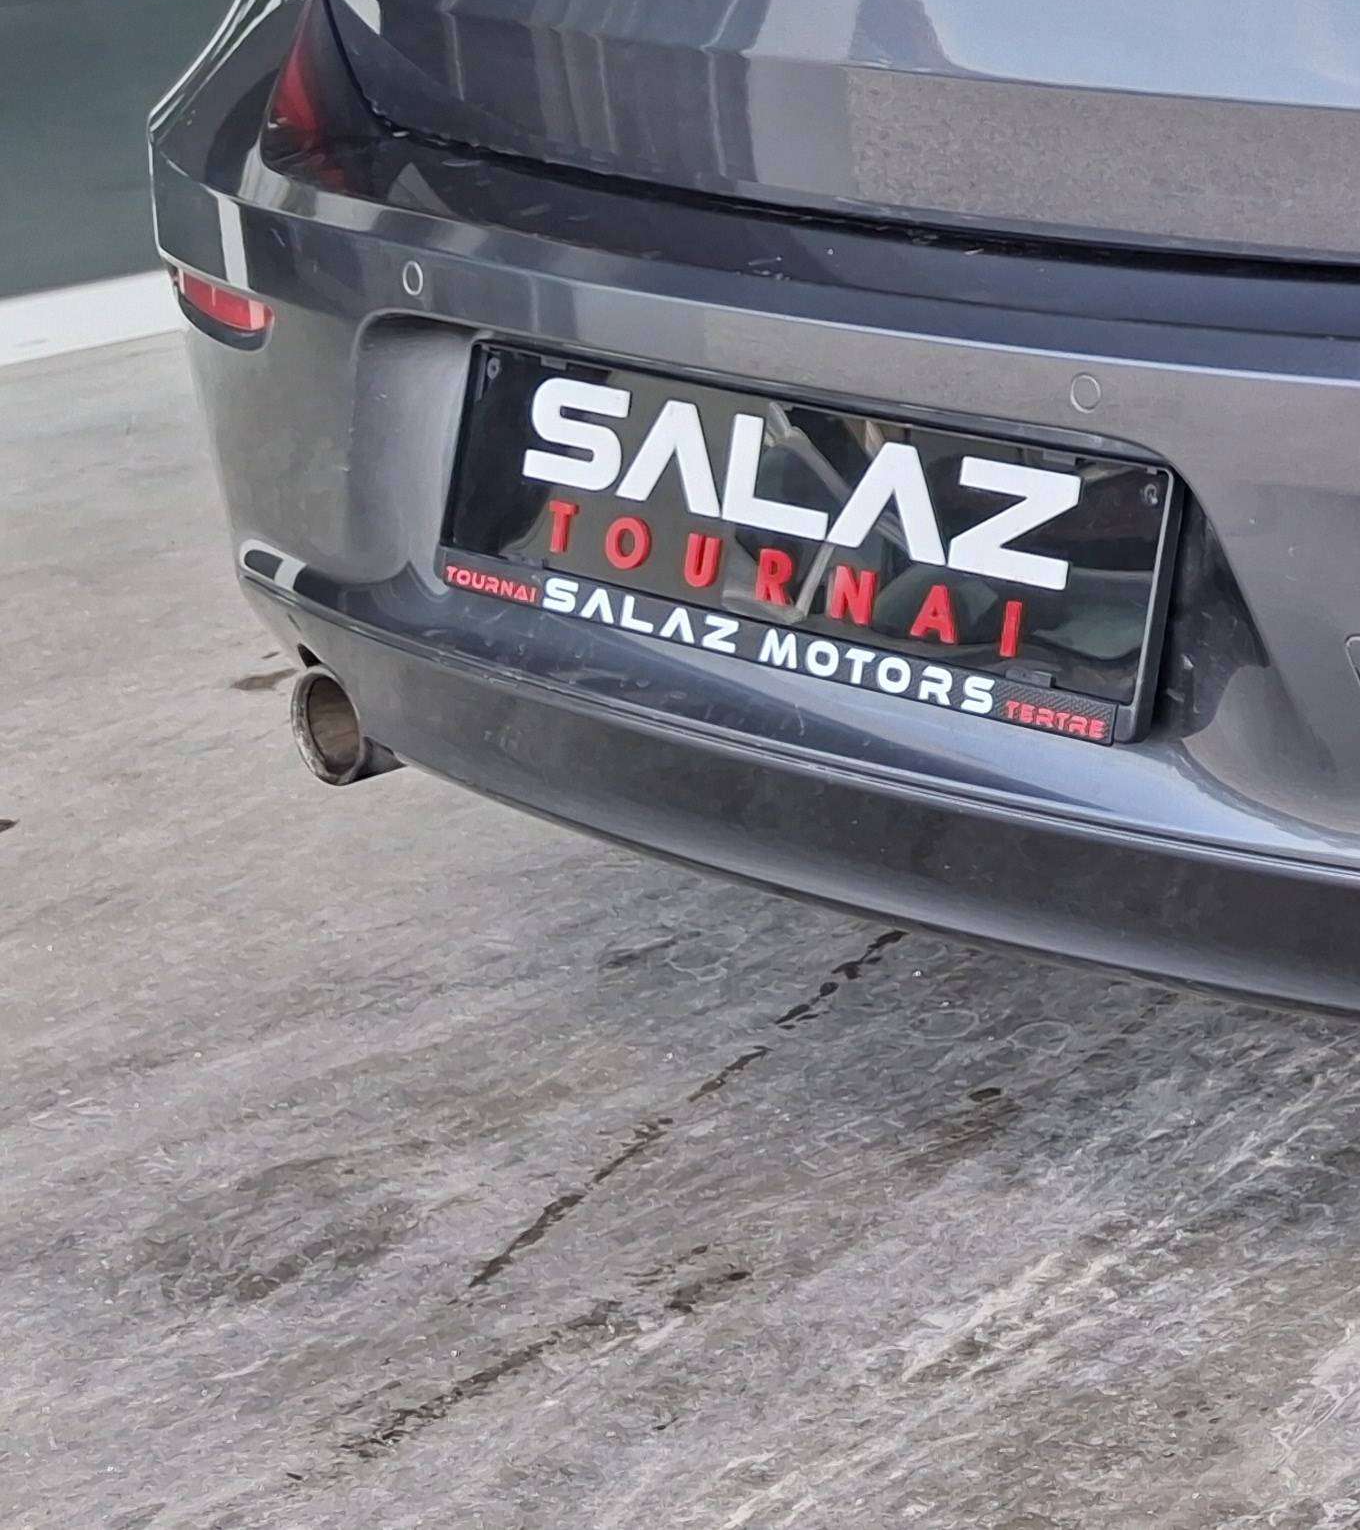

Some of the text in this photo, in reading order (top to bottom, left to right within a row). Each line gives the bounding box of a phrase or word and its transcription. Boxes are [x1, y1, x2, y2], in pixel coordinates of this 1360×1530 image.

[521, 376, 1083, 592] SALAZ
[445, 564, 1108, 741] TOURNAI SALAZ MOTORS TERTRE
[548, 499, 1024, 659] TOURNAI
